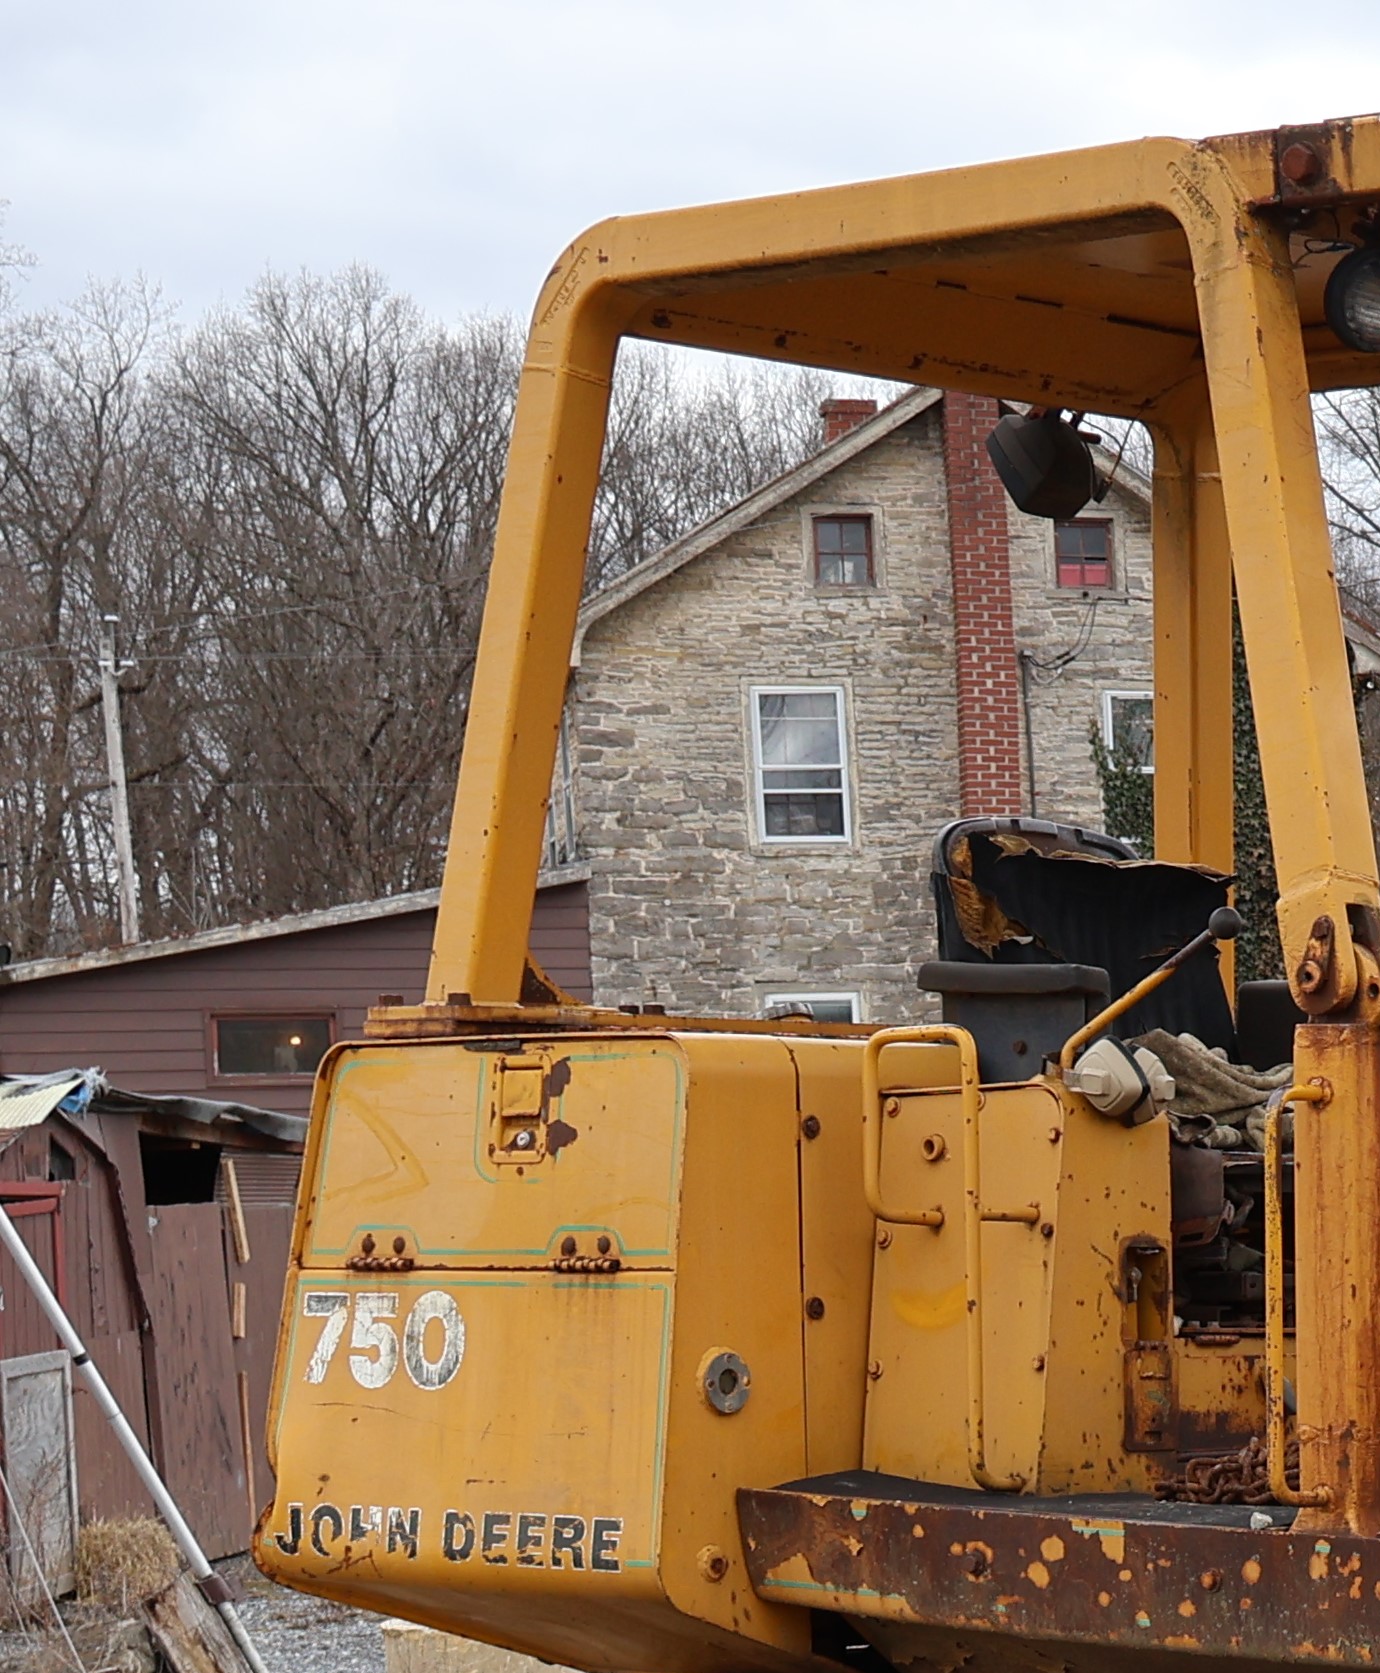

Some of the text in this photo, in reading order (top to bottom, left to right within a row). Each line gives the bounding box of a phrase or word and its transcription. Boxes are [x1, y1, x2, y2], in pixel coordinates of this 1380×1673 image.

[303, 1291, 465, 1391] 750
[274, 1502, 624, 1574] JOHN DEERE
